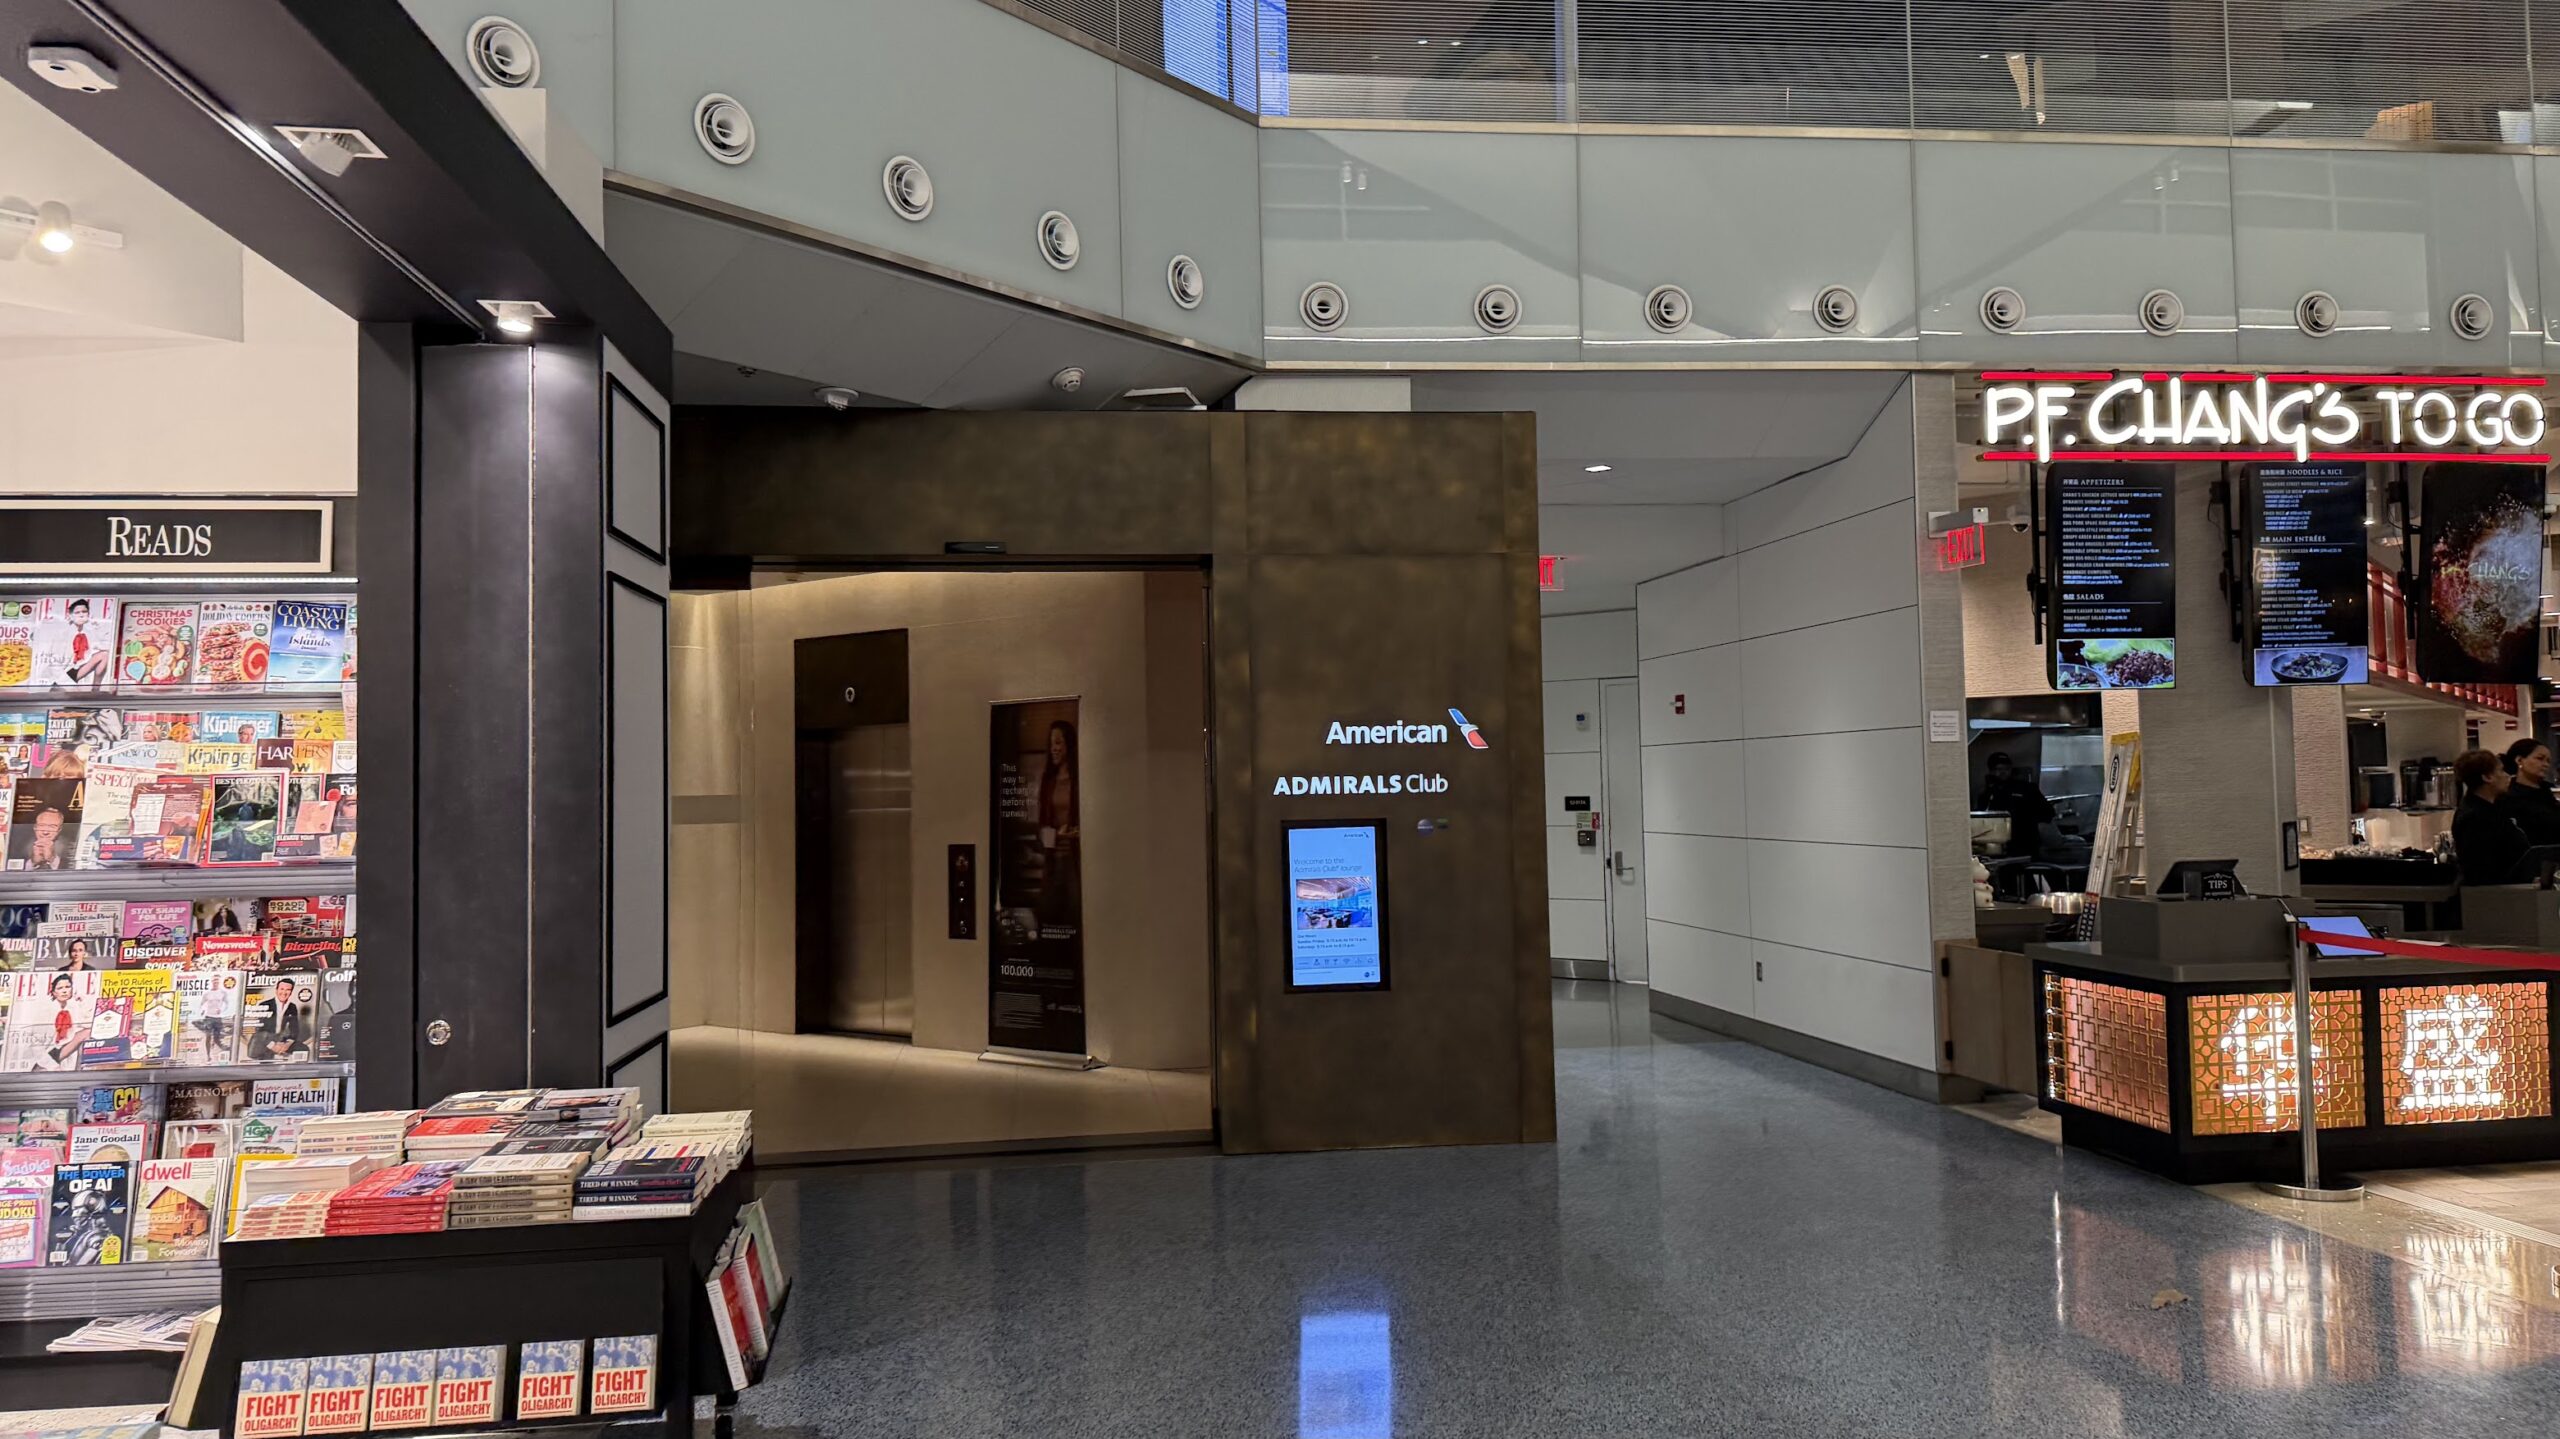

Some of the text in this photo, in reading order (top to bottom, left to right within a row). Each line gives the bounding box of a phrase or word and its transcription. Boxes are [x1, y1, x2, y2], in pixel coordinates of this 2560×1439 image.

[1985, 376, 2545, 463] P.F. CHANG'S TO GO
[106, 516, 212, 556] READS
[1948, 526, 1974, 564] EXIT
[1540, 558, 1554, 586] IT
[130, 610, 192, 618] CHRISTMAS
[136, 618, 186, 626] COOKIES
[282, 616, 340, 630] LIVING
[289, 636, 330, 646] Islands
[47, 729, 71, 738] SWIFT
[1325, 720, 1448, 744] American
[188, 748, 256, 770] Kiplinger
[1273, 773, 1448, 796] ADMIRALS Club
[2208, 880, 2228, 888] TIPS
[78, 903, 98, 912] LIFE
[139, 914, 158, 922] FOR
[66, 922, 86, 932] LIFE
[124, 947, 187, 957] DISCOVER
[202, 940, 258, 950] Newsweek
[284, 942, 341, 952] Bicycling
[144, 962, 186, 971] SCIENCE
[120, 978, 129, 986] 10
[132, 978, 153, 986] Rules
[155, 977, 164, 985] of
[176, 981, 210, 990] MUSCLE
[175, 1086, 240, 1098] MAGNOLIA
[254, 1090, 326, 1105] GUT HEALTH
[74, 1134, 140, 1144] Jane Goodall
[58, 1169, 125, 1180] THE POWER
[143, 1161, 192, 1180] dwell
[69, 1179, 112, 1192] OF AI
[580, 1180, 599, 1189] TIRED
[600, 1180, 609, 1188] OF
[610, 1179, 639, 1188] WINNING
[578, 1194, 637, 1203] TIRED OF WINNING
[522, 1374, 576, 1398] FIGHT
[595, 1369, 648, 1392] FIGHT
[375, 1385, 429, 1409] FIGHT
[439, 1380, 492, 1404] FIGHT
[594, 1392, 646, 1406] OLIGARCHY
[246, 1394, 300, 1418] FIGHT
[310, 1390, 365, 1413] FIGHT
[521, 1397, 574, 1412] OLIGARCHY
[374, 1408, 427, 1423] OLIGARCHY
[438, 1403, 491, 1418] OLIGARCHY
[244, 1417, 298, 1432] OLIGARCHY
[308, 1412, 362, 1428] OLIGARCHY
